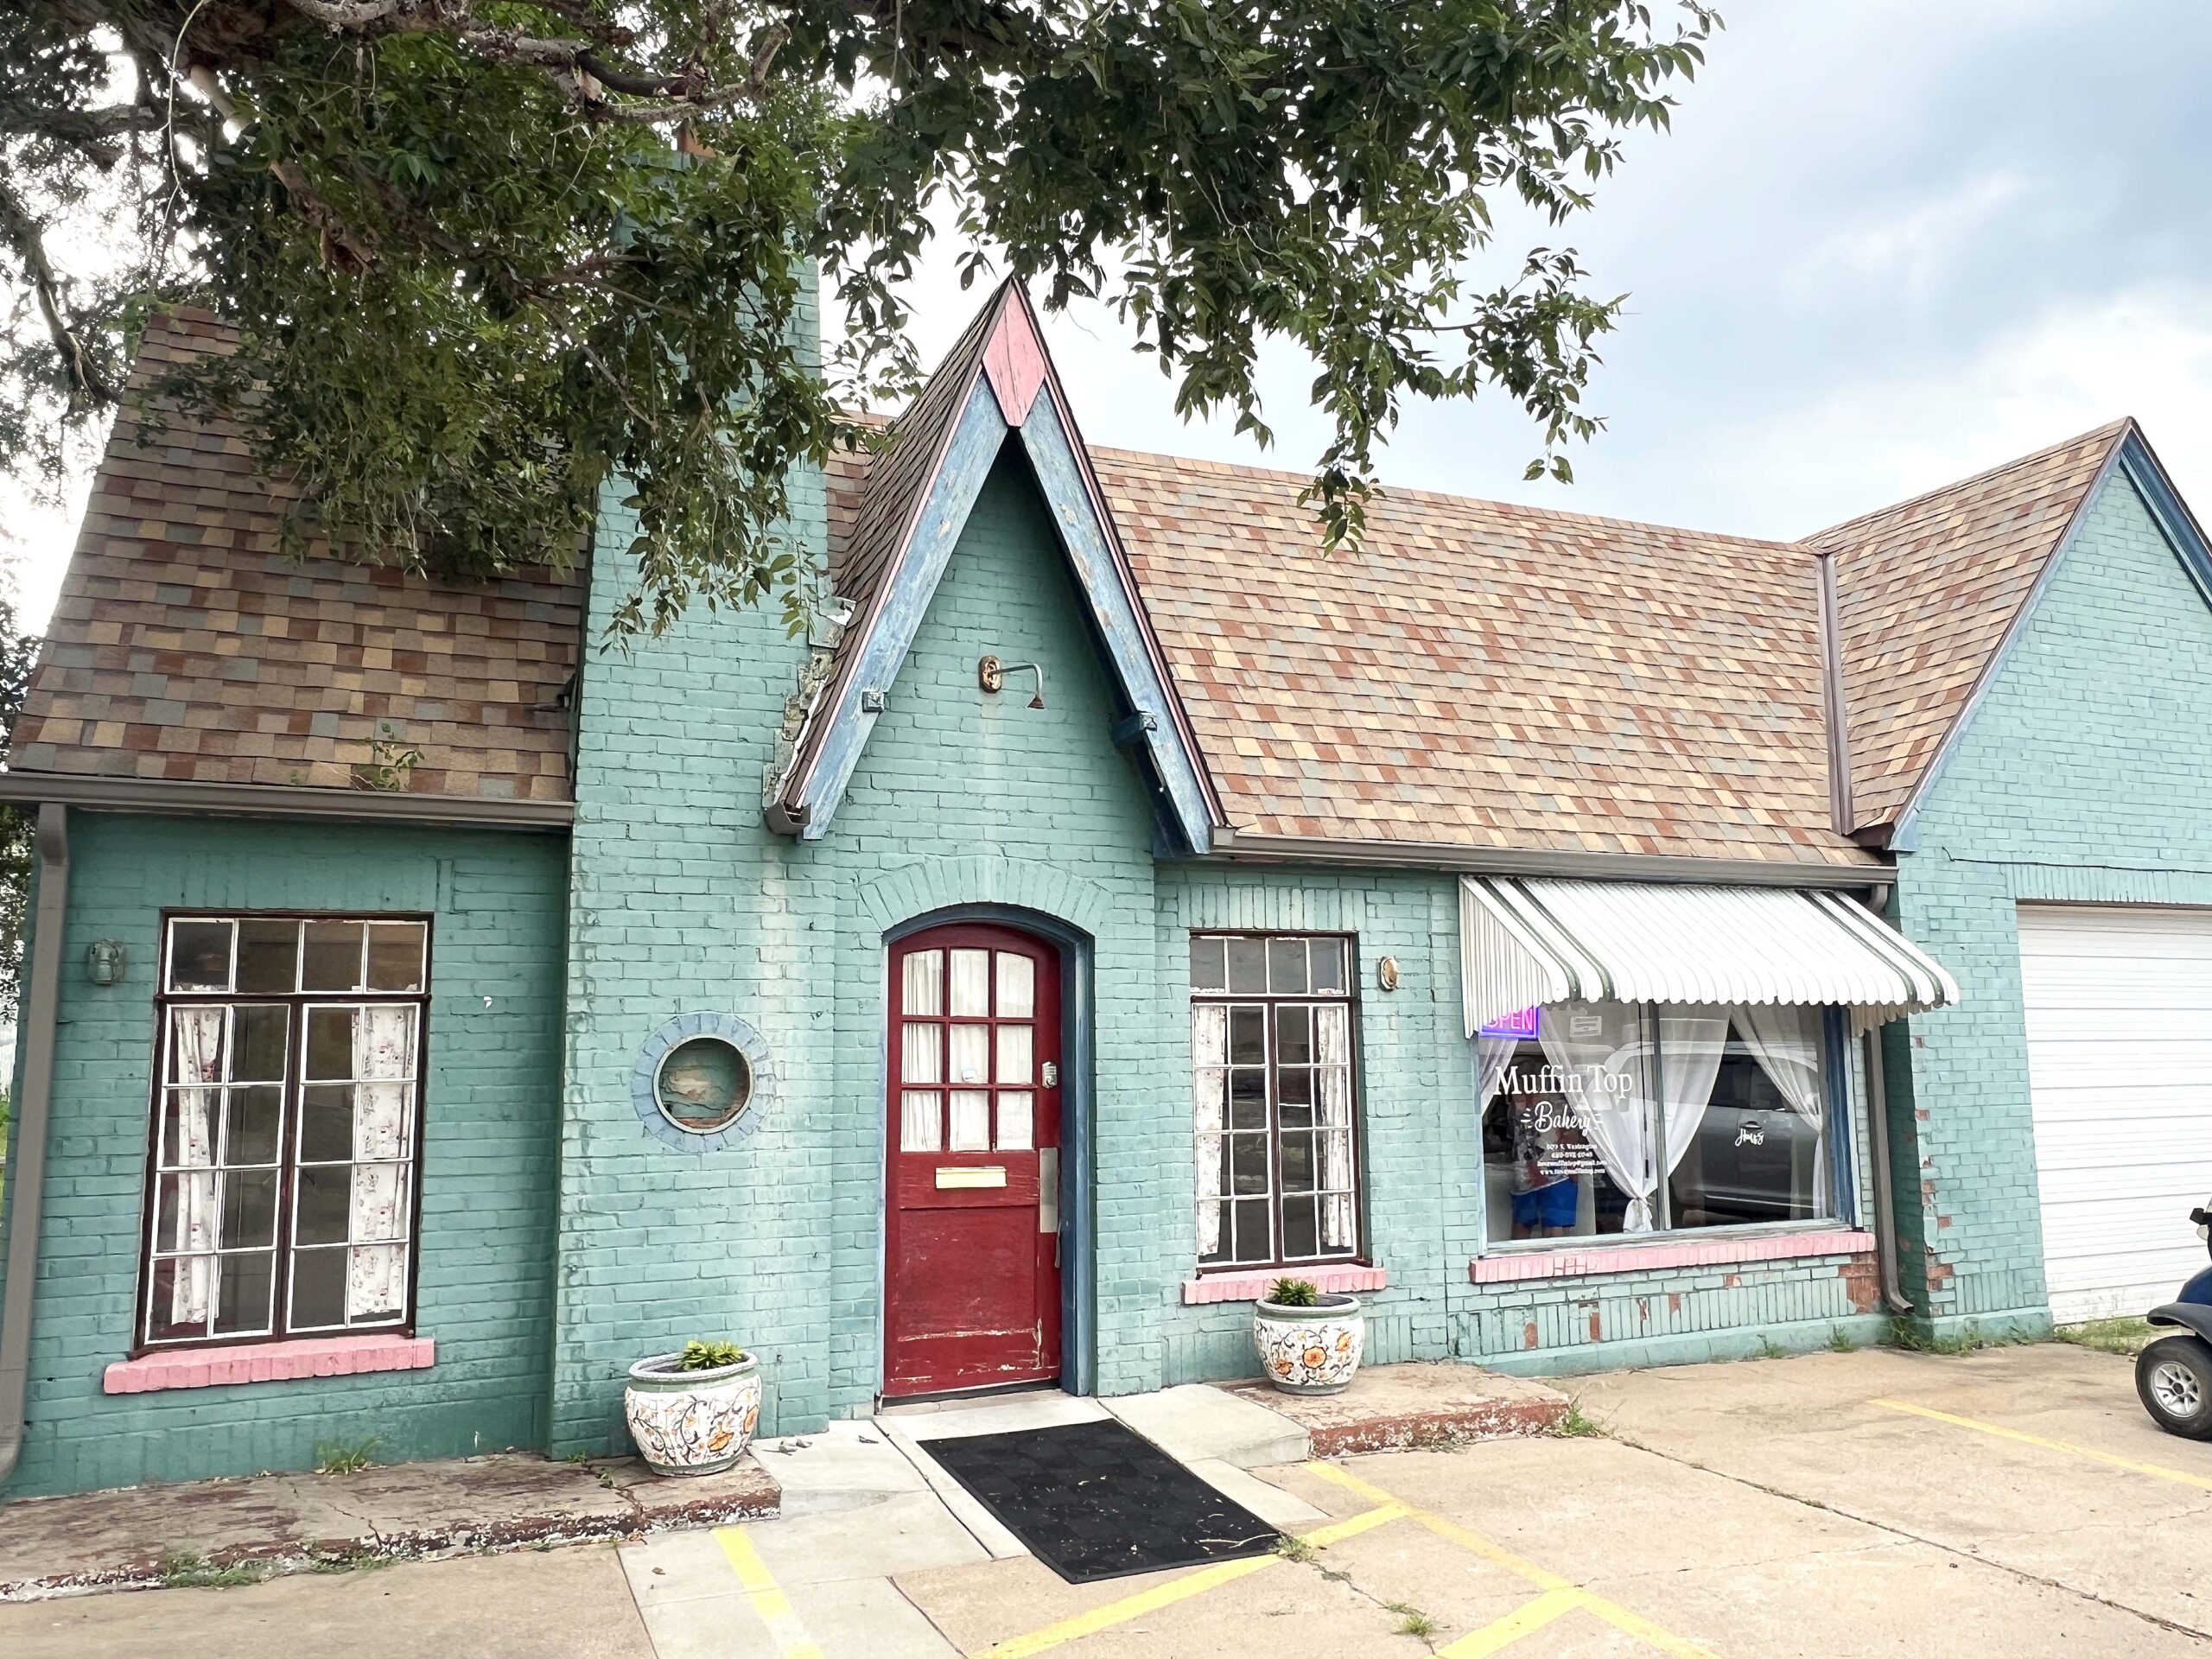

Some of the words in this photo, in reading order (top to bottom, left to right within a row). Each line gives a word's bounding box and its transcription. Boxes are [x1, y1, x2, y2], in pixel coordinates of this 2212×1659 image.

[1493, 1064, 1584, 1095] Muffin
[1586, 1064, 1633, 1099] Top
[1534, 1100, 1592, 1137] Bakery
